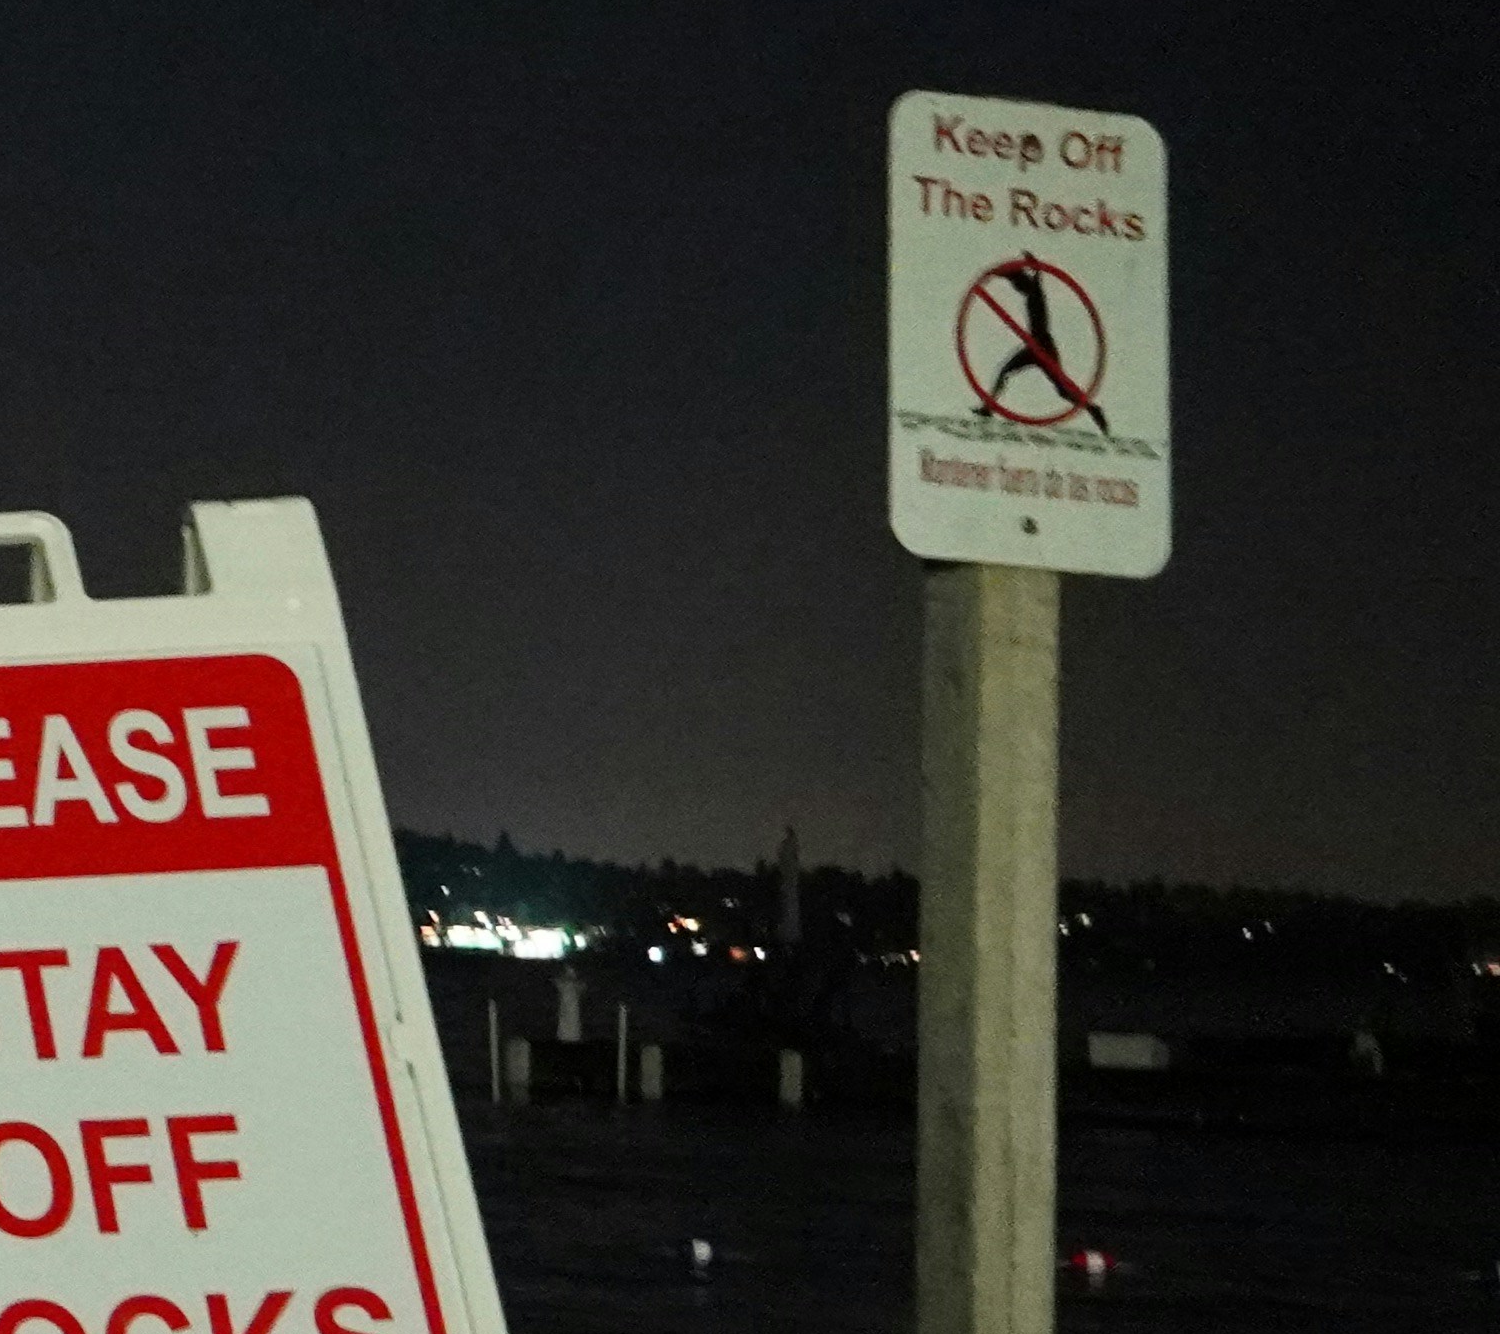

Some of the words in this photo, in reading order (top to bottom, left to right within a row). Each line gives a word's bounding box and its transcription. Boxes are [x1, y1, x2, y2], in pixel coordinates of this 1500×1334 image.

[932, 113, 1044, 173] Keep
[1058, 130, 1124, 174] Off
[912, 173, 994, 224] The
[1008, 187, 1147, 242] Rocks
